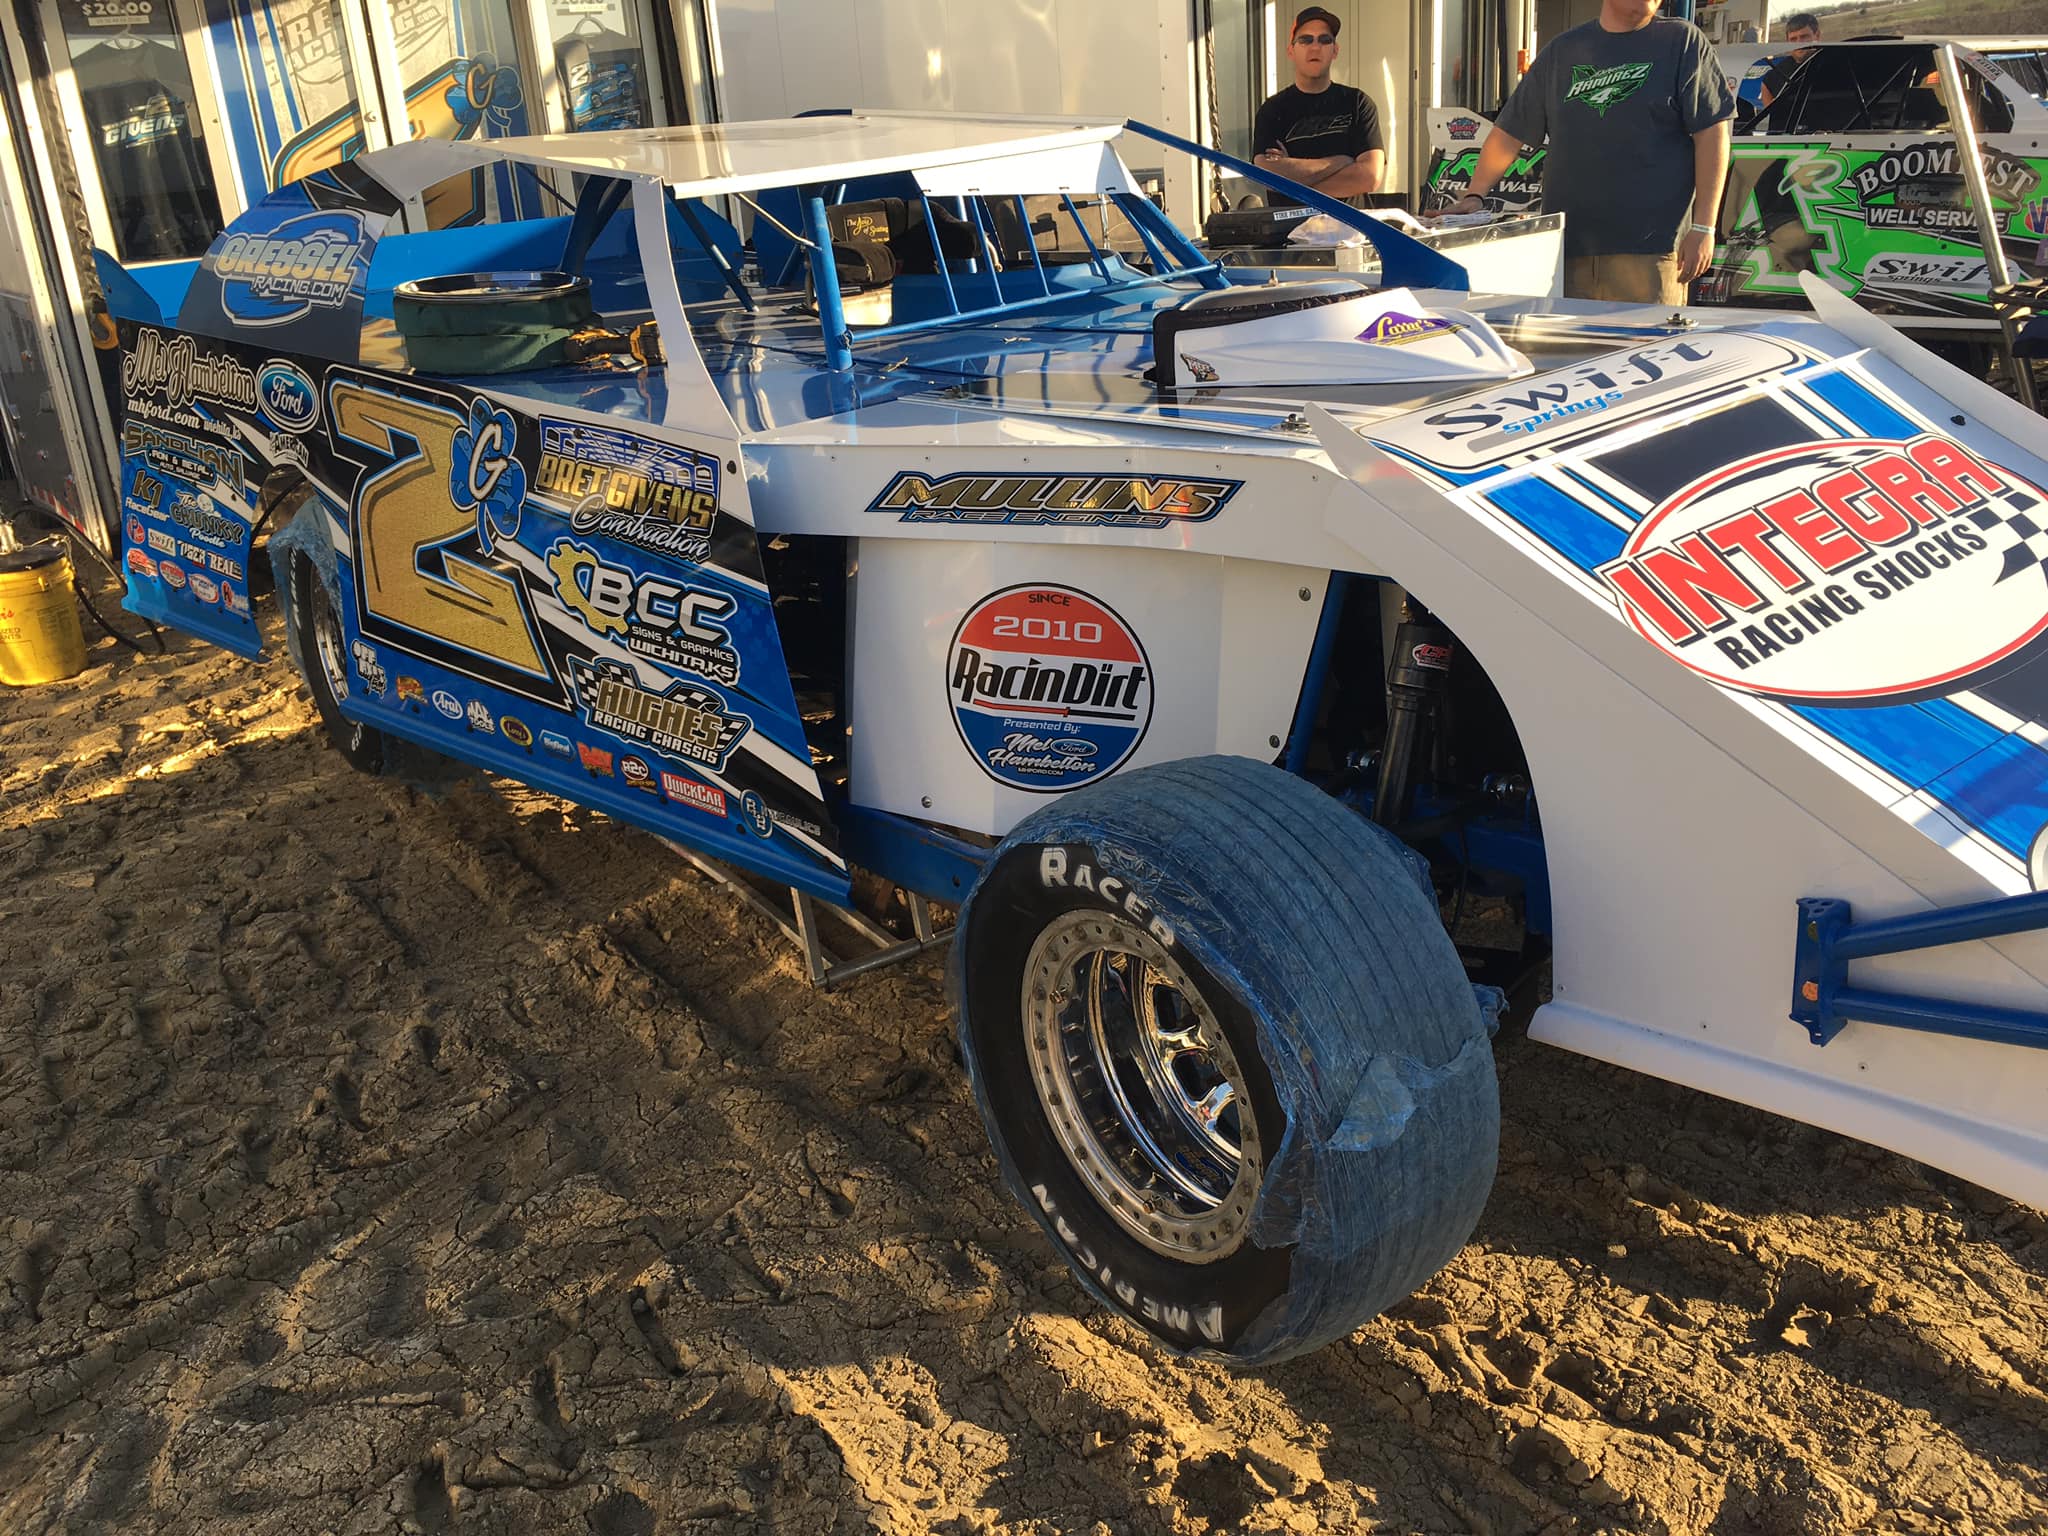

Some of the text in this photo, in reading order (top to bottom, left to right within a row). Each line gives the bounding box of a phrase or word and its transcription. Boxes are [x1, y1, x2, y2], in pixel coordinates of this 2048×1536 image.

[81, 1, 153, 16] $20.00
[104, 113, 185, 145] GIVENS
[1500, 181, 1543, 193] WAS
[1857, 149, 2034, 197] BOOMEST
[1870, 207, 2006, 229] WELL SERVE
[216, 236, 358, 283] GRESSEL
[253, 274, 347, 299] RACING.COM
[1376, 315, 1437, 341] Larry's
[123, 332, 257, 405] Mel Hambelton
[127, 399, 201, 430] mhford.com
[270, 374, 304, 416] Ford
[1502, 390, 1625, 436] springs
[124, 422, 244, 496] SANDLIAN
[467, 421, 509, 501] G
[125, 497, 170, 522] RaceGear
[131, 470, 164, 509] K1
[176, 489, 198, 508] The
[536, 453, 715, 529] BRET GIVENS
[878, 475, 1225, 516] MULLINS
[169, 502, 244, 545] CHUNKY
[335, 378, 550, 685] 2
[571, 493, 711, 560] Construction
[911, 510, 1168, 525] RACE ENGINES
[189, 528, 226, 549] Poodle
[1600, 435, 2009, 648] INTEGRA
[589, 565, 729, 642] BCC
[1028, 592, 1071, 606] SINCE
[1713, 523, 1989, 671] RACING SHOCKS
[631, 625, 735, 663] SIGNS & GRAPHICS
[992, 615, 1103, 644] 2010
[952, 647, 1147, 710] RacinDirt
[596, 680, 723, 750] HUGHES
[1003, 718, 1082, 734] Presented By:
[594, 711, 647, 739] RACING
[651, 731, 720, 766] CHASSIS
[1003, 733, 1088, 753] Mel Ford
[621, 760, 648, 779] R2C
[988, 748, 1097, 773] Hambelton
[1039, 846, 1176, 946] RACER
